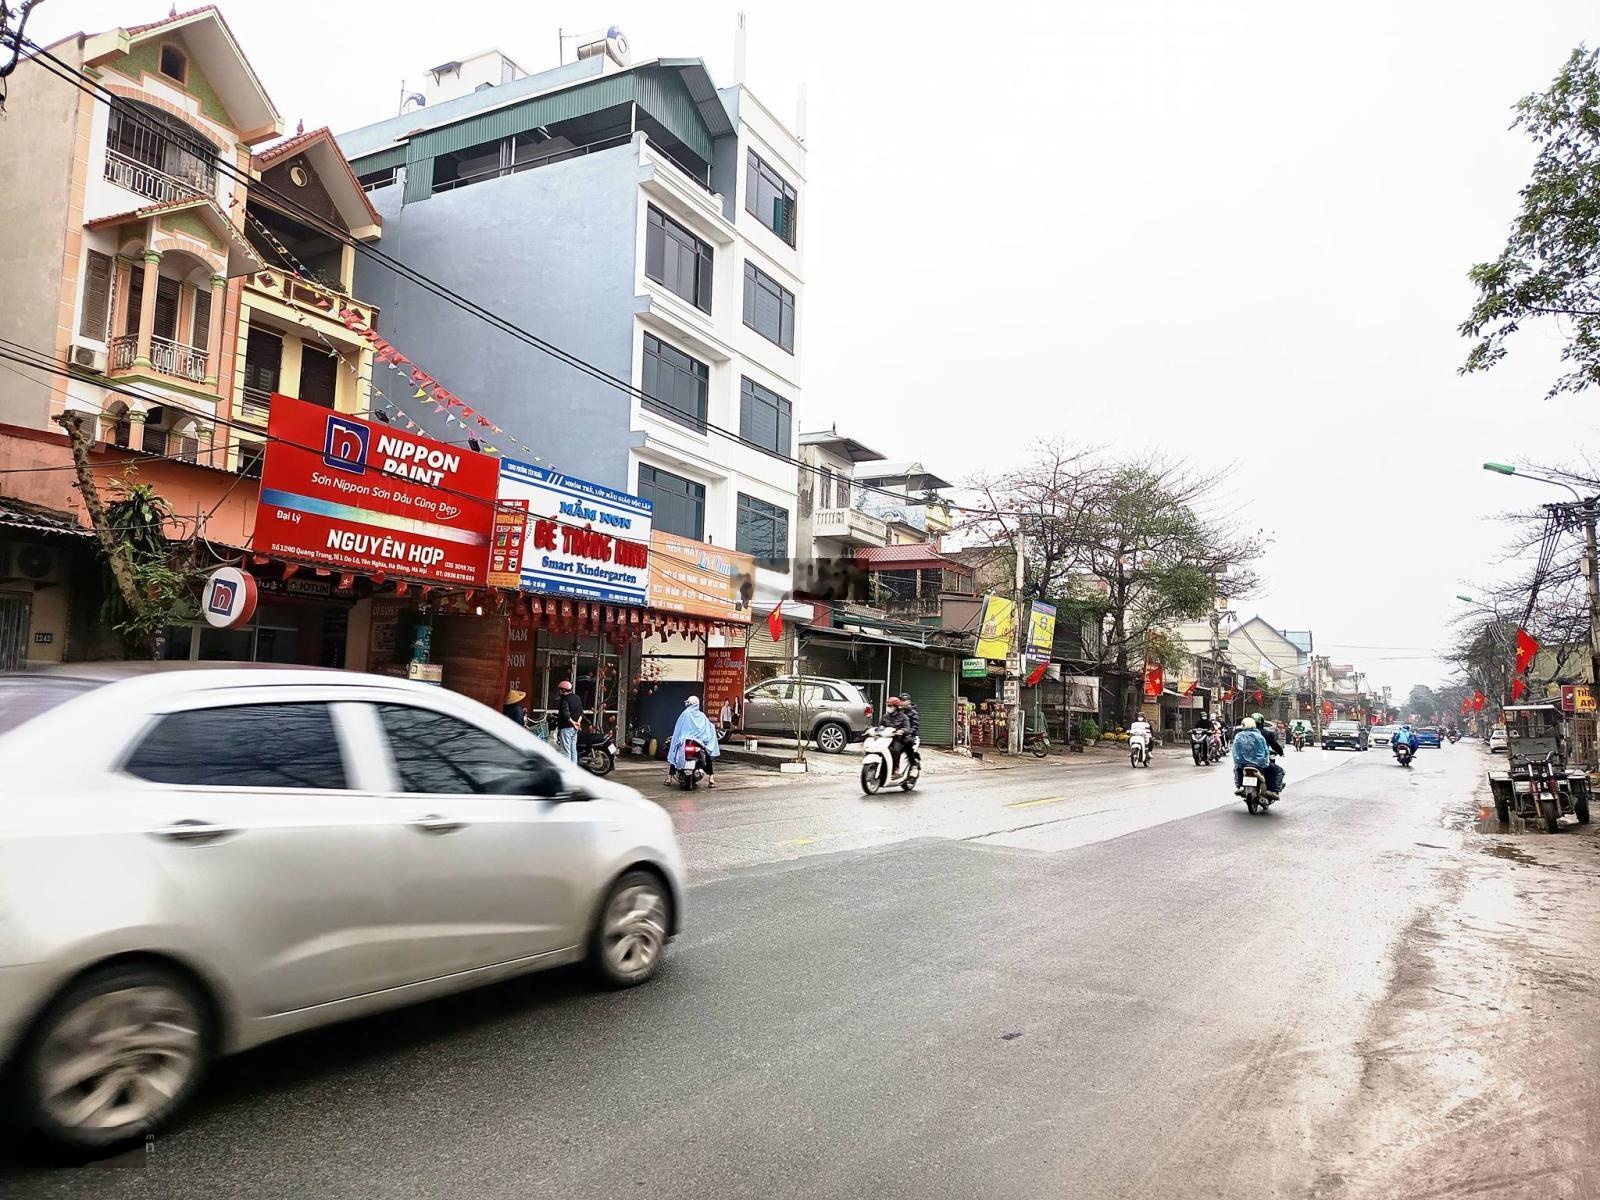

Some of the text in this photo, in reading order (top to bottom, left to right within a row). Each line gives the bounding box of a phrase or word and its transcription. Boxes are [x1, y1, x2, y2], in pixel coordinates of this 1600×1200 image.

[377, 435, 460, 473] NIPPON
[382, 458, 445, 489] PAINT
[312, 472, 331, 487] Sơn
[333, 478, 370, 495] Nippon
[372, 487, 390, 500] Sơn
[414, 496, 437, 512] Cũng
[439, 502, 457, 515] Đẹp
[276, 510, 302, 524] Đại Lý
[559, 499, 632, 529] MẦM NON
[326, 529, 445, 568] NGUYÊN HỢP
[534, 515, 558, 551] BÉ
[296, 547, 315, 557] Quang
[542, 555, 637, 584] Smart Kindergarten
